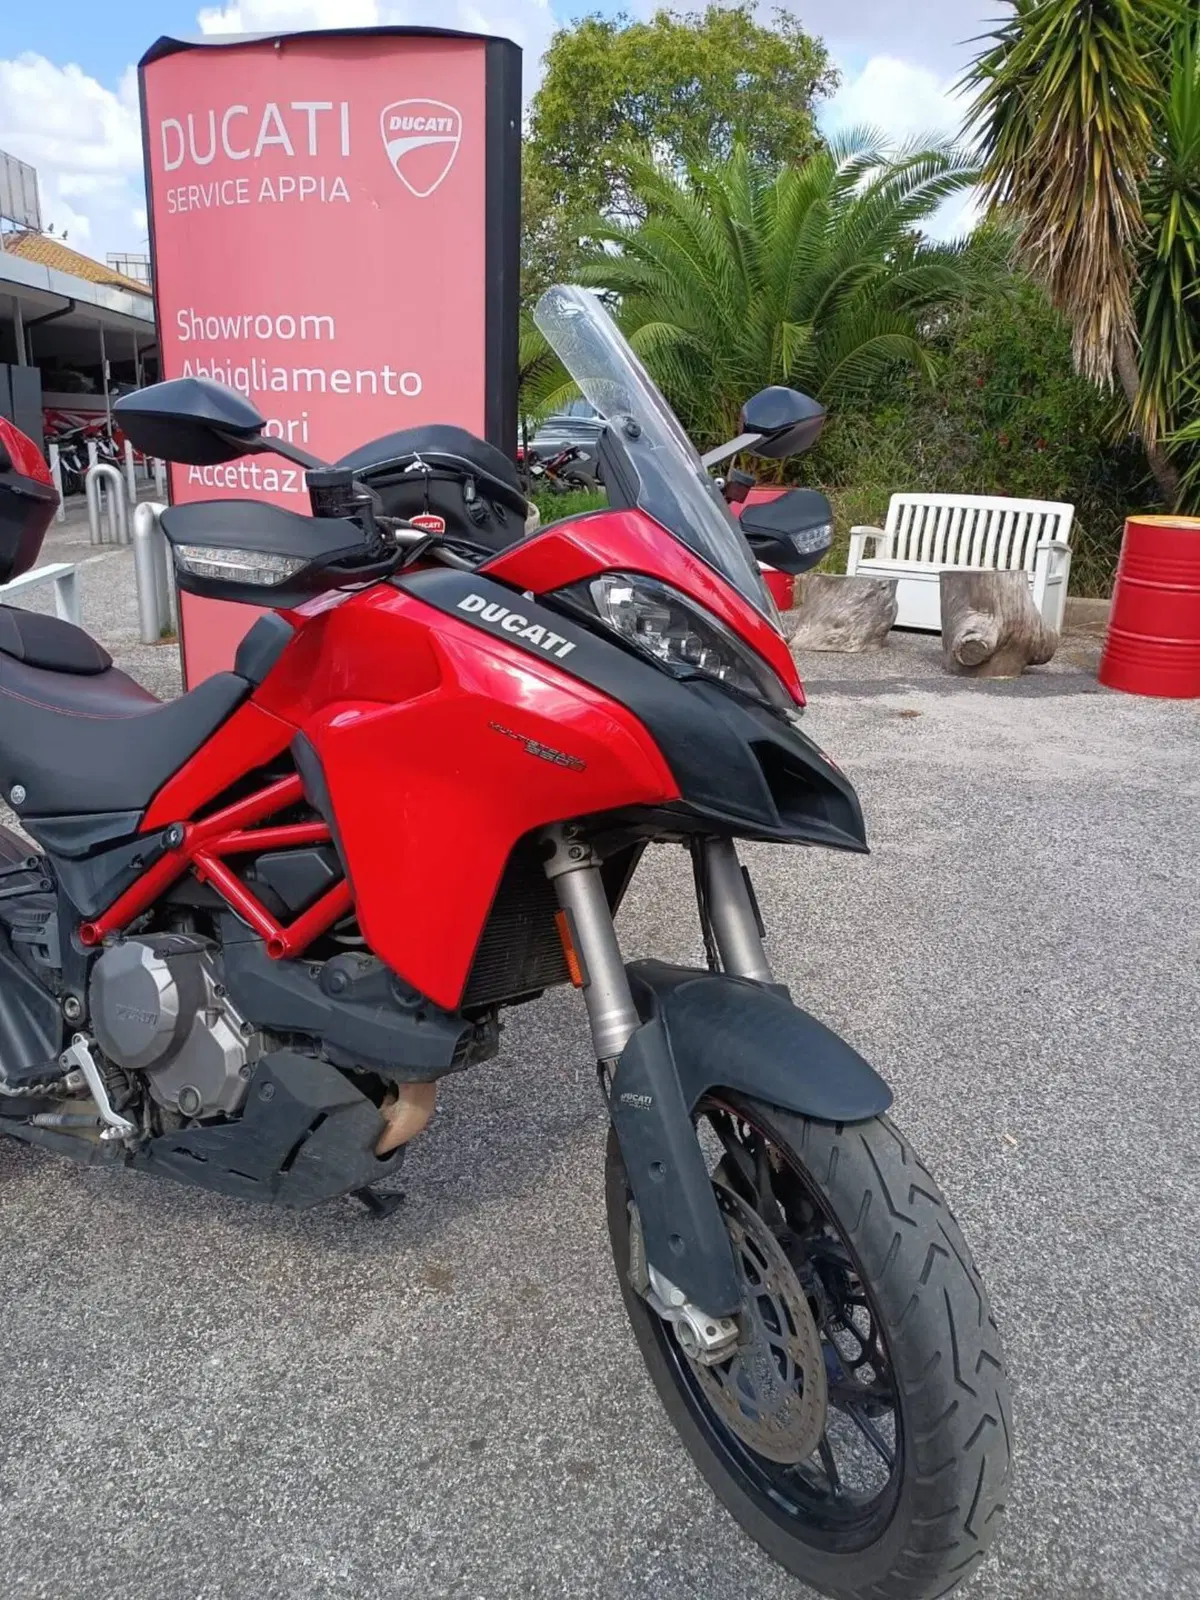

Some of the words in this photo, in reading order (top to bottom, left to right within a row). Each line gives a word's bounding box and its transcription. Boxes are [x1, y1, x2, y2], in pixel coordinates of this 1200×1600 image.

[160, 101, 350, 171] DUCATI
[389, 115, 453, 132] DUCATI
[167, 178, 250, 213] SERVICE
[258, 176, 351, 203] APPIA
[177, 308, 335, 341] Showroom
[456, 593, 577, 659] DUCATI
